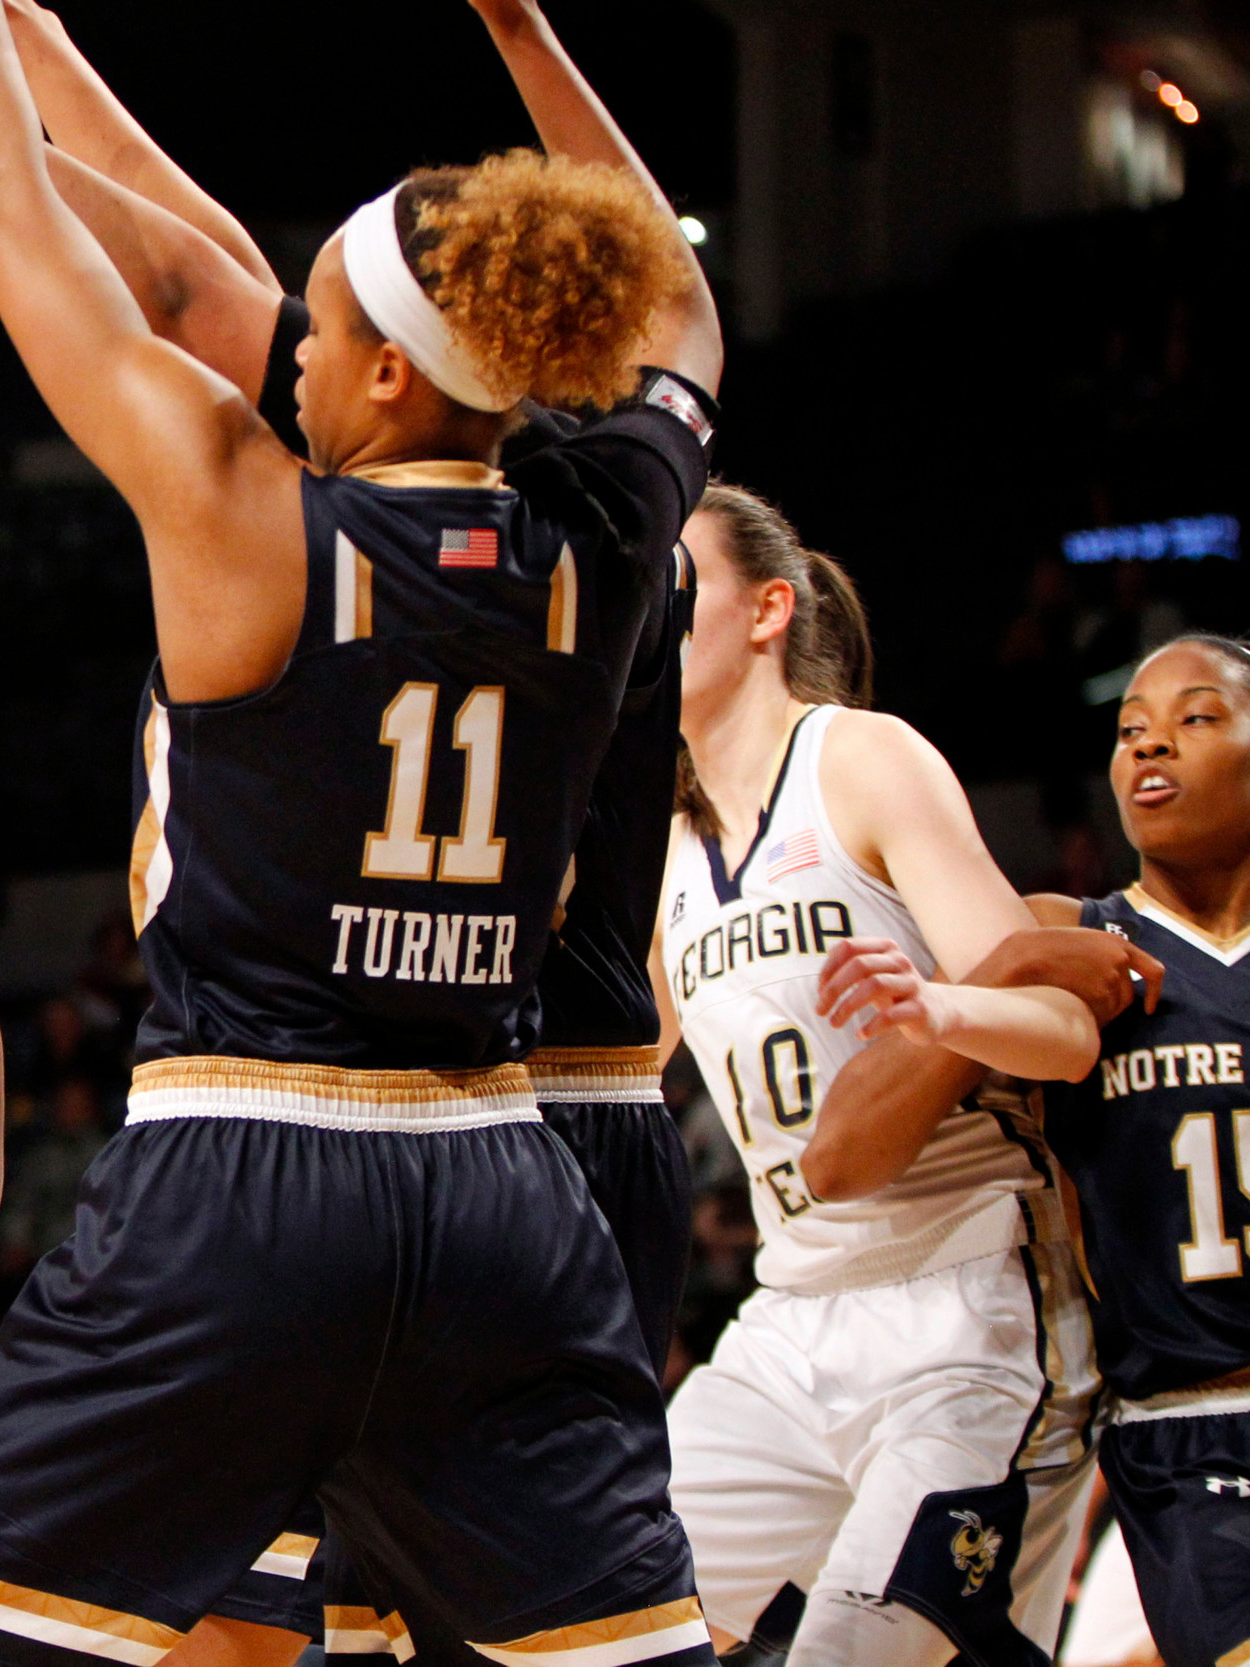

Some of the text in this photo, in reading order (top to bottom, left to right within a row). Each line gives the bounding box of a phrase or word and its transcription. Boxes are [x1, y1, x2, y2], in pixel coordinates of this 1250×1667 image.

[361, 681, 506, 883] 11
[331, 904, 516, 984] TURNER
[673, 900, 855, 1002] EORGIA
[725, 1022, 817, 1151] 10
[1101, 1042, 1245, 1100] NOTRE
